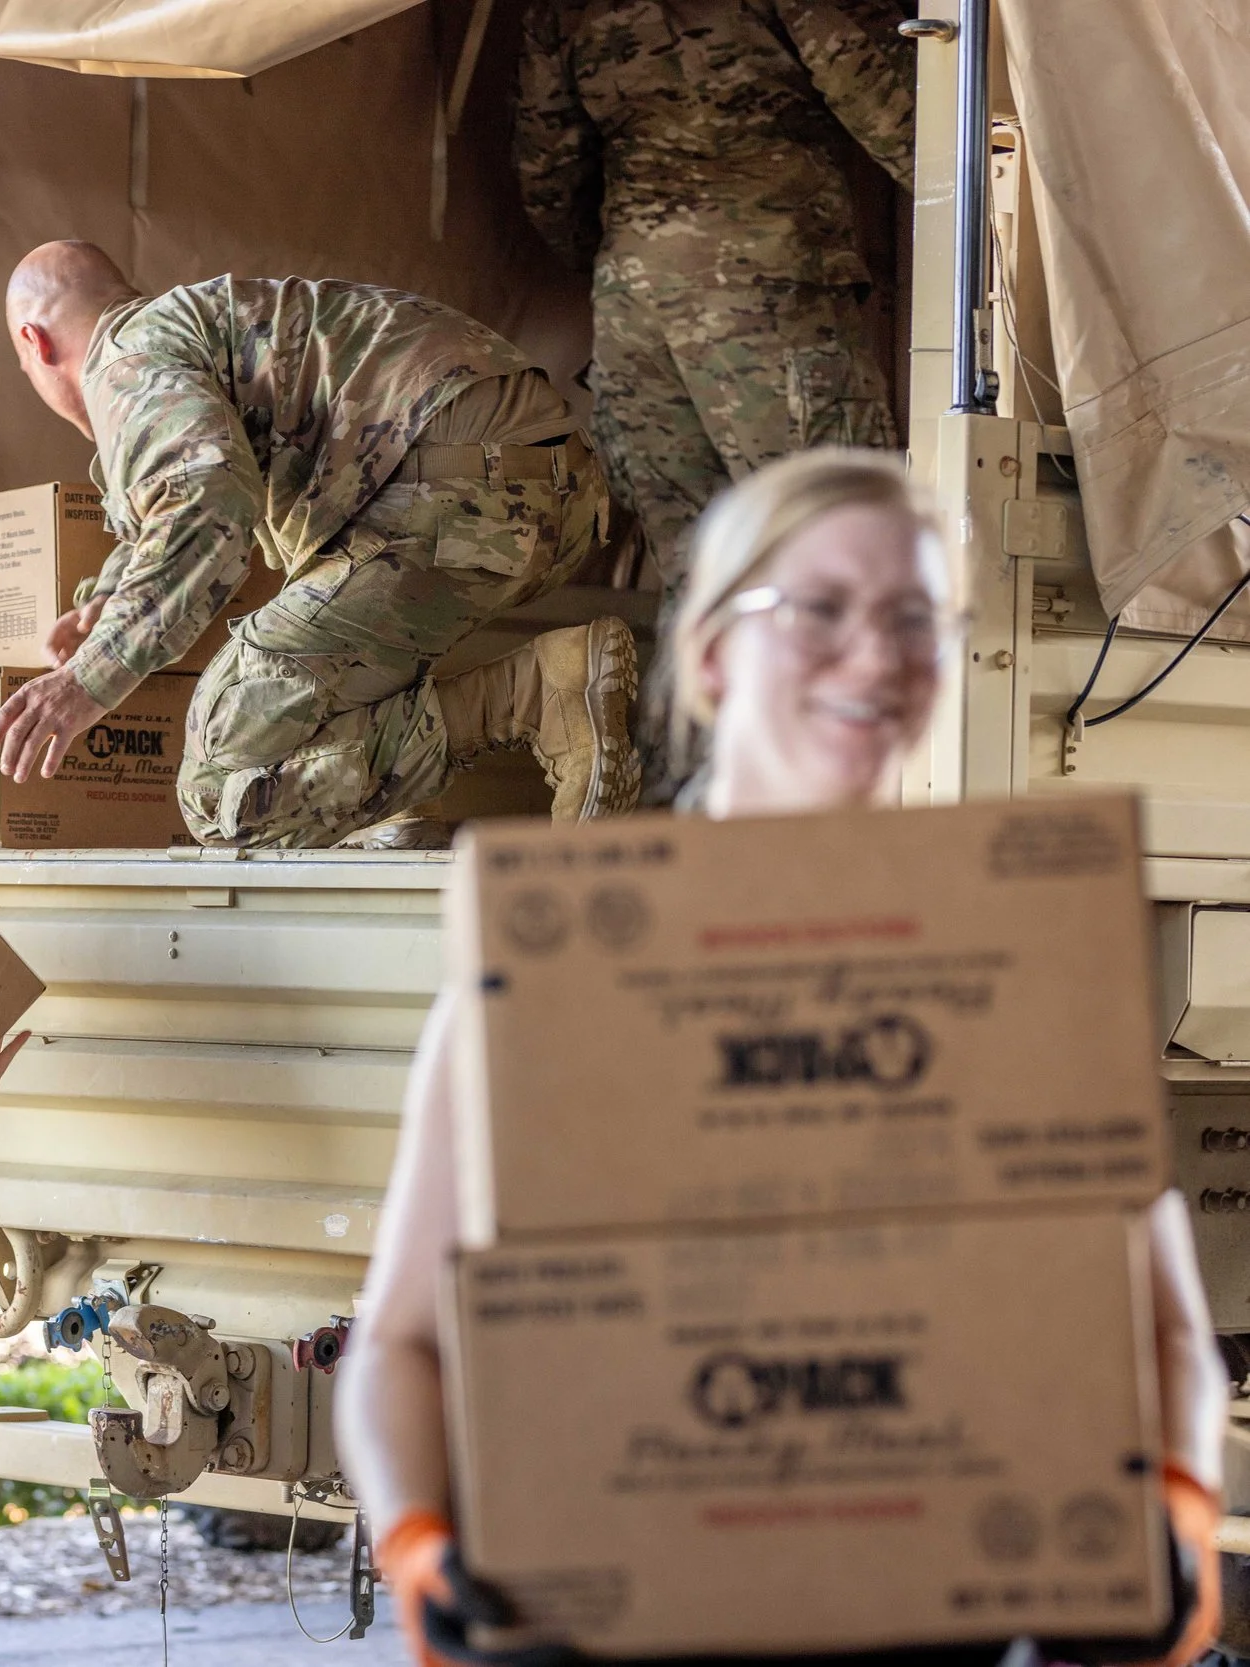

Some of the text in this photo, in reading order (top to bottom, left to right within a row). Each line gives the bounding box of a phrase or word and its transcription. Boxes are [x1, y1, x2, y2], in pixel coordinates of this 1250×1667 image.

[65, 493, 83, 503] DATE
[65, 509, 104, 521] INSP/TEST
[62, 755, 131, 785] Ready
[86, 790, 167, 803] REDUCED SODIUM
[172, 834, 187, 845] NET
